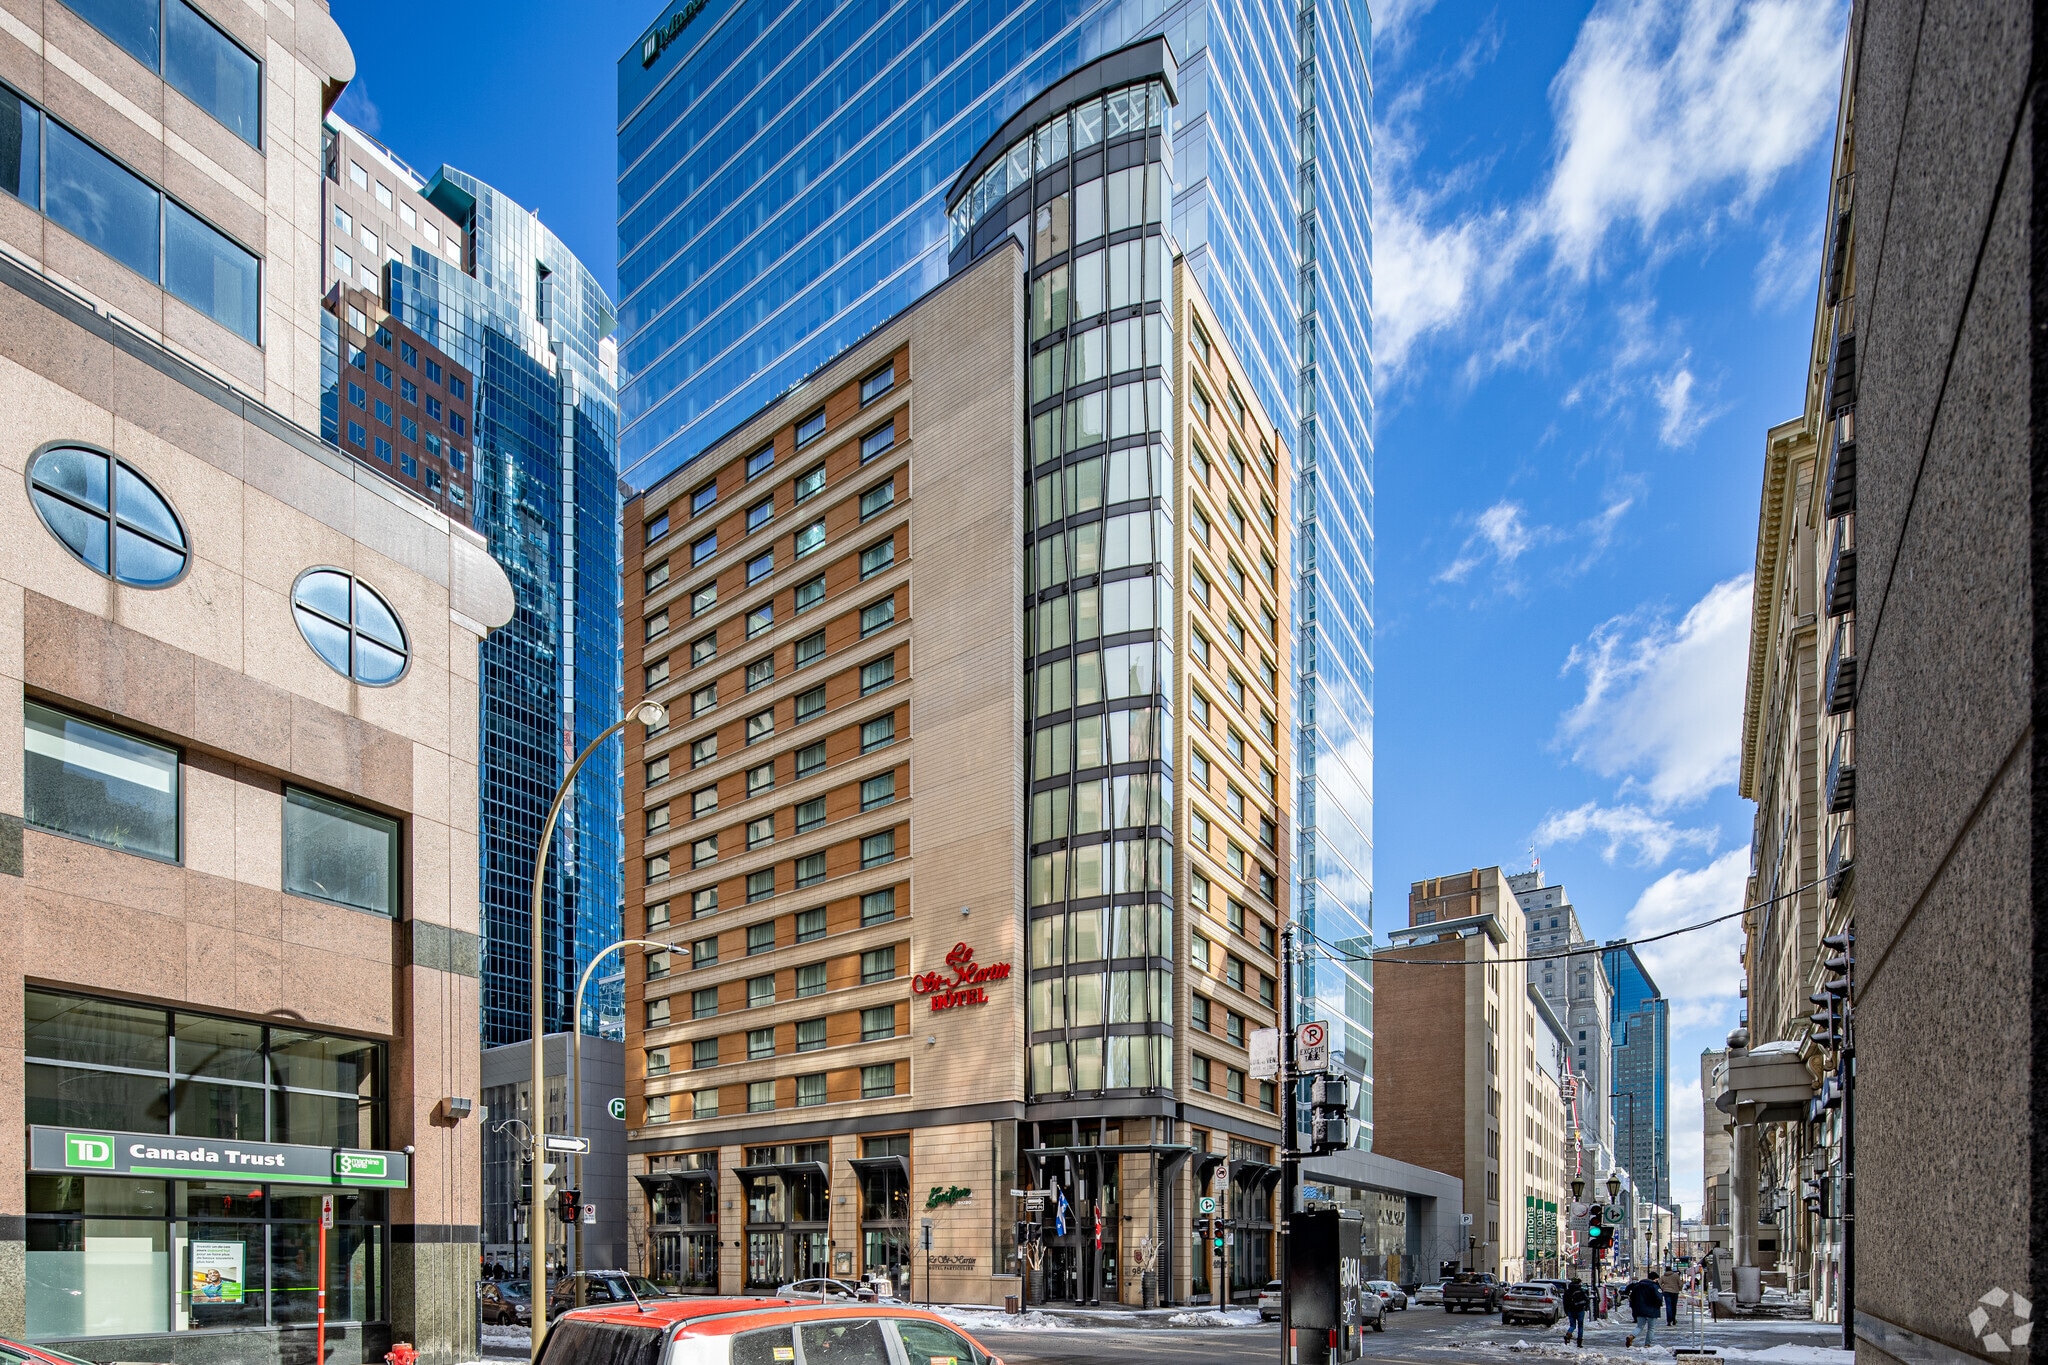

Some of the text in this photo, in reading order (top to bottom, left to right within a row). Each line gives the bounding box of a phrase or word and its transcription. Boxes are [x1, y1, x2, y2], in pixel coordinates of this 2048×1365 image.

[945, 941, 974, 966] Le
[912, 961, 1011, 994] St-Martin
[930, 987, 989, 1012] HÔTEL
[614, 1101, 625, 1116] P
[70, 1139, 109, 1162] TD
[130, 1144, 285, 1168] Canada Trust
